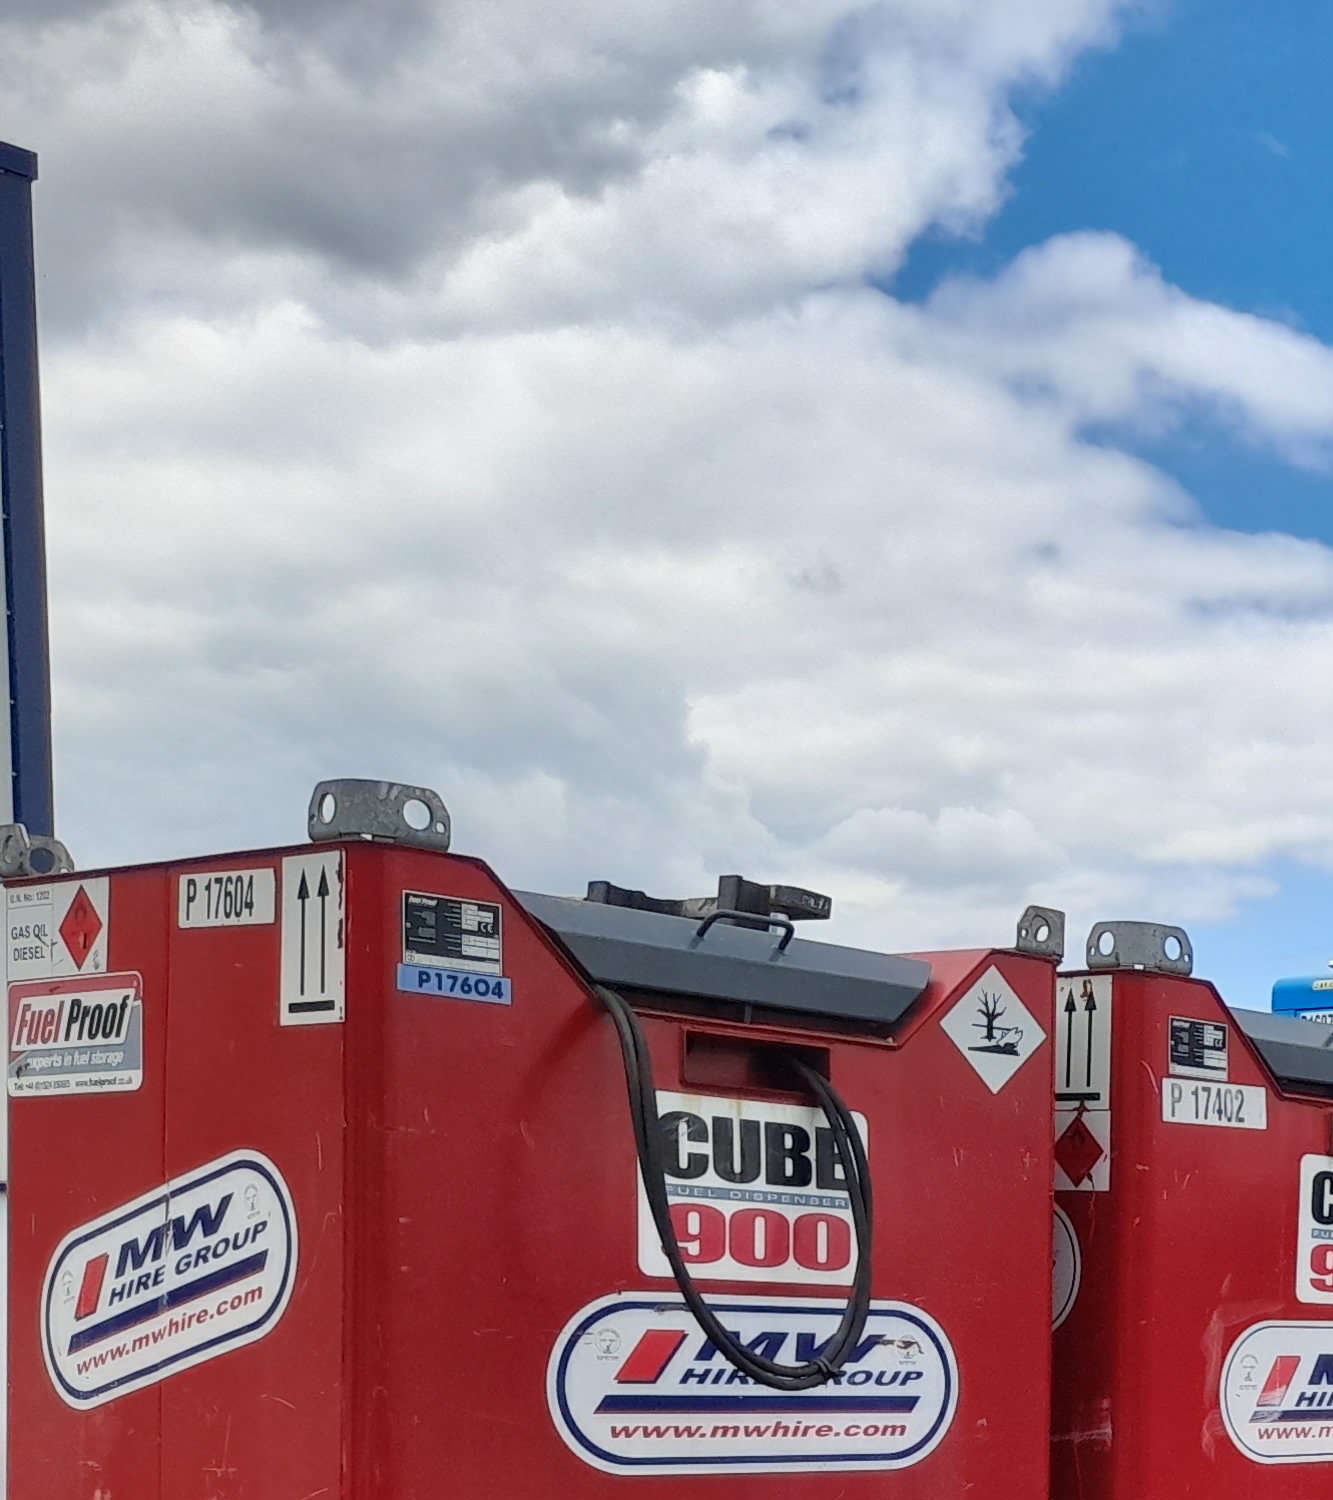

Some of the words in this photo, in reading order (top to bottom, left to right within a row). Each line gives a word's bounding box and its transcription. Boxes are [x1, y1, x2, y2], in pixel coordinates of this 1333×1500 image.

[186, 878, 197, 921] P
[204, 874, 254, 920] 17604
[11, 925, 31, 940] GAS
[13, 946, 45, 961] DIESEL
[418, 970, 504, 999] P17604
[16, 1000, 65, 1046] Fuel
[64, 994, 130, 1042] Proof
[73, 1050, 90, 1066] fuel
[91, 1050, 124, 1067] storage
[1170, 1083, 1183, 1118] P
[1191, 1087, 1245, 1123] 17402
[657, 1111, 850, 1191] CUBE
[729, 1190, 847, 1208] DISPENSER
[115, 1192, 234, 1279] MW
[668, 1203, 851, 1271] 900
[108, 1265, 166, 1307] HIRE
[175, 1220, 268, 1276] GROUP
[76, 1286, 263, 1376] www.mwhire.com
[694, 1330, 887, 1364] MW
[831, 1369, 924, 1388] ROUP
[610, 1420, 907, 1441] www.mwhire.com
